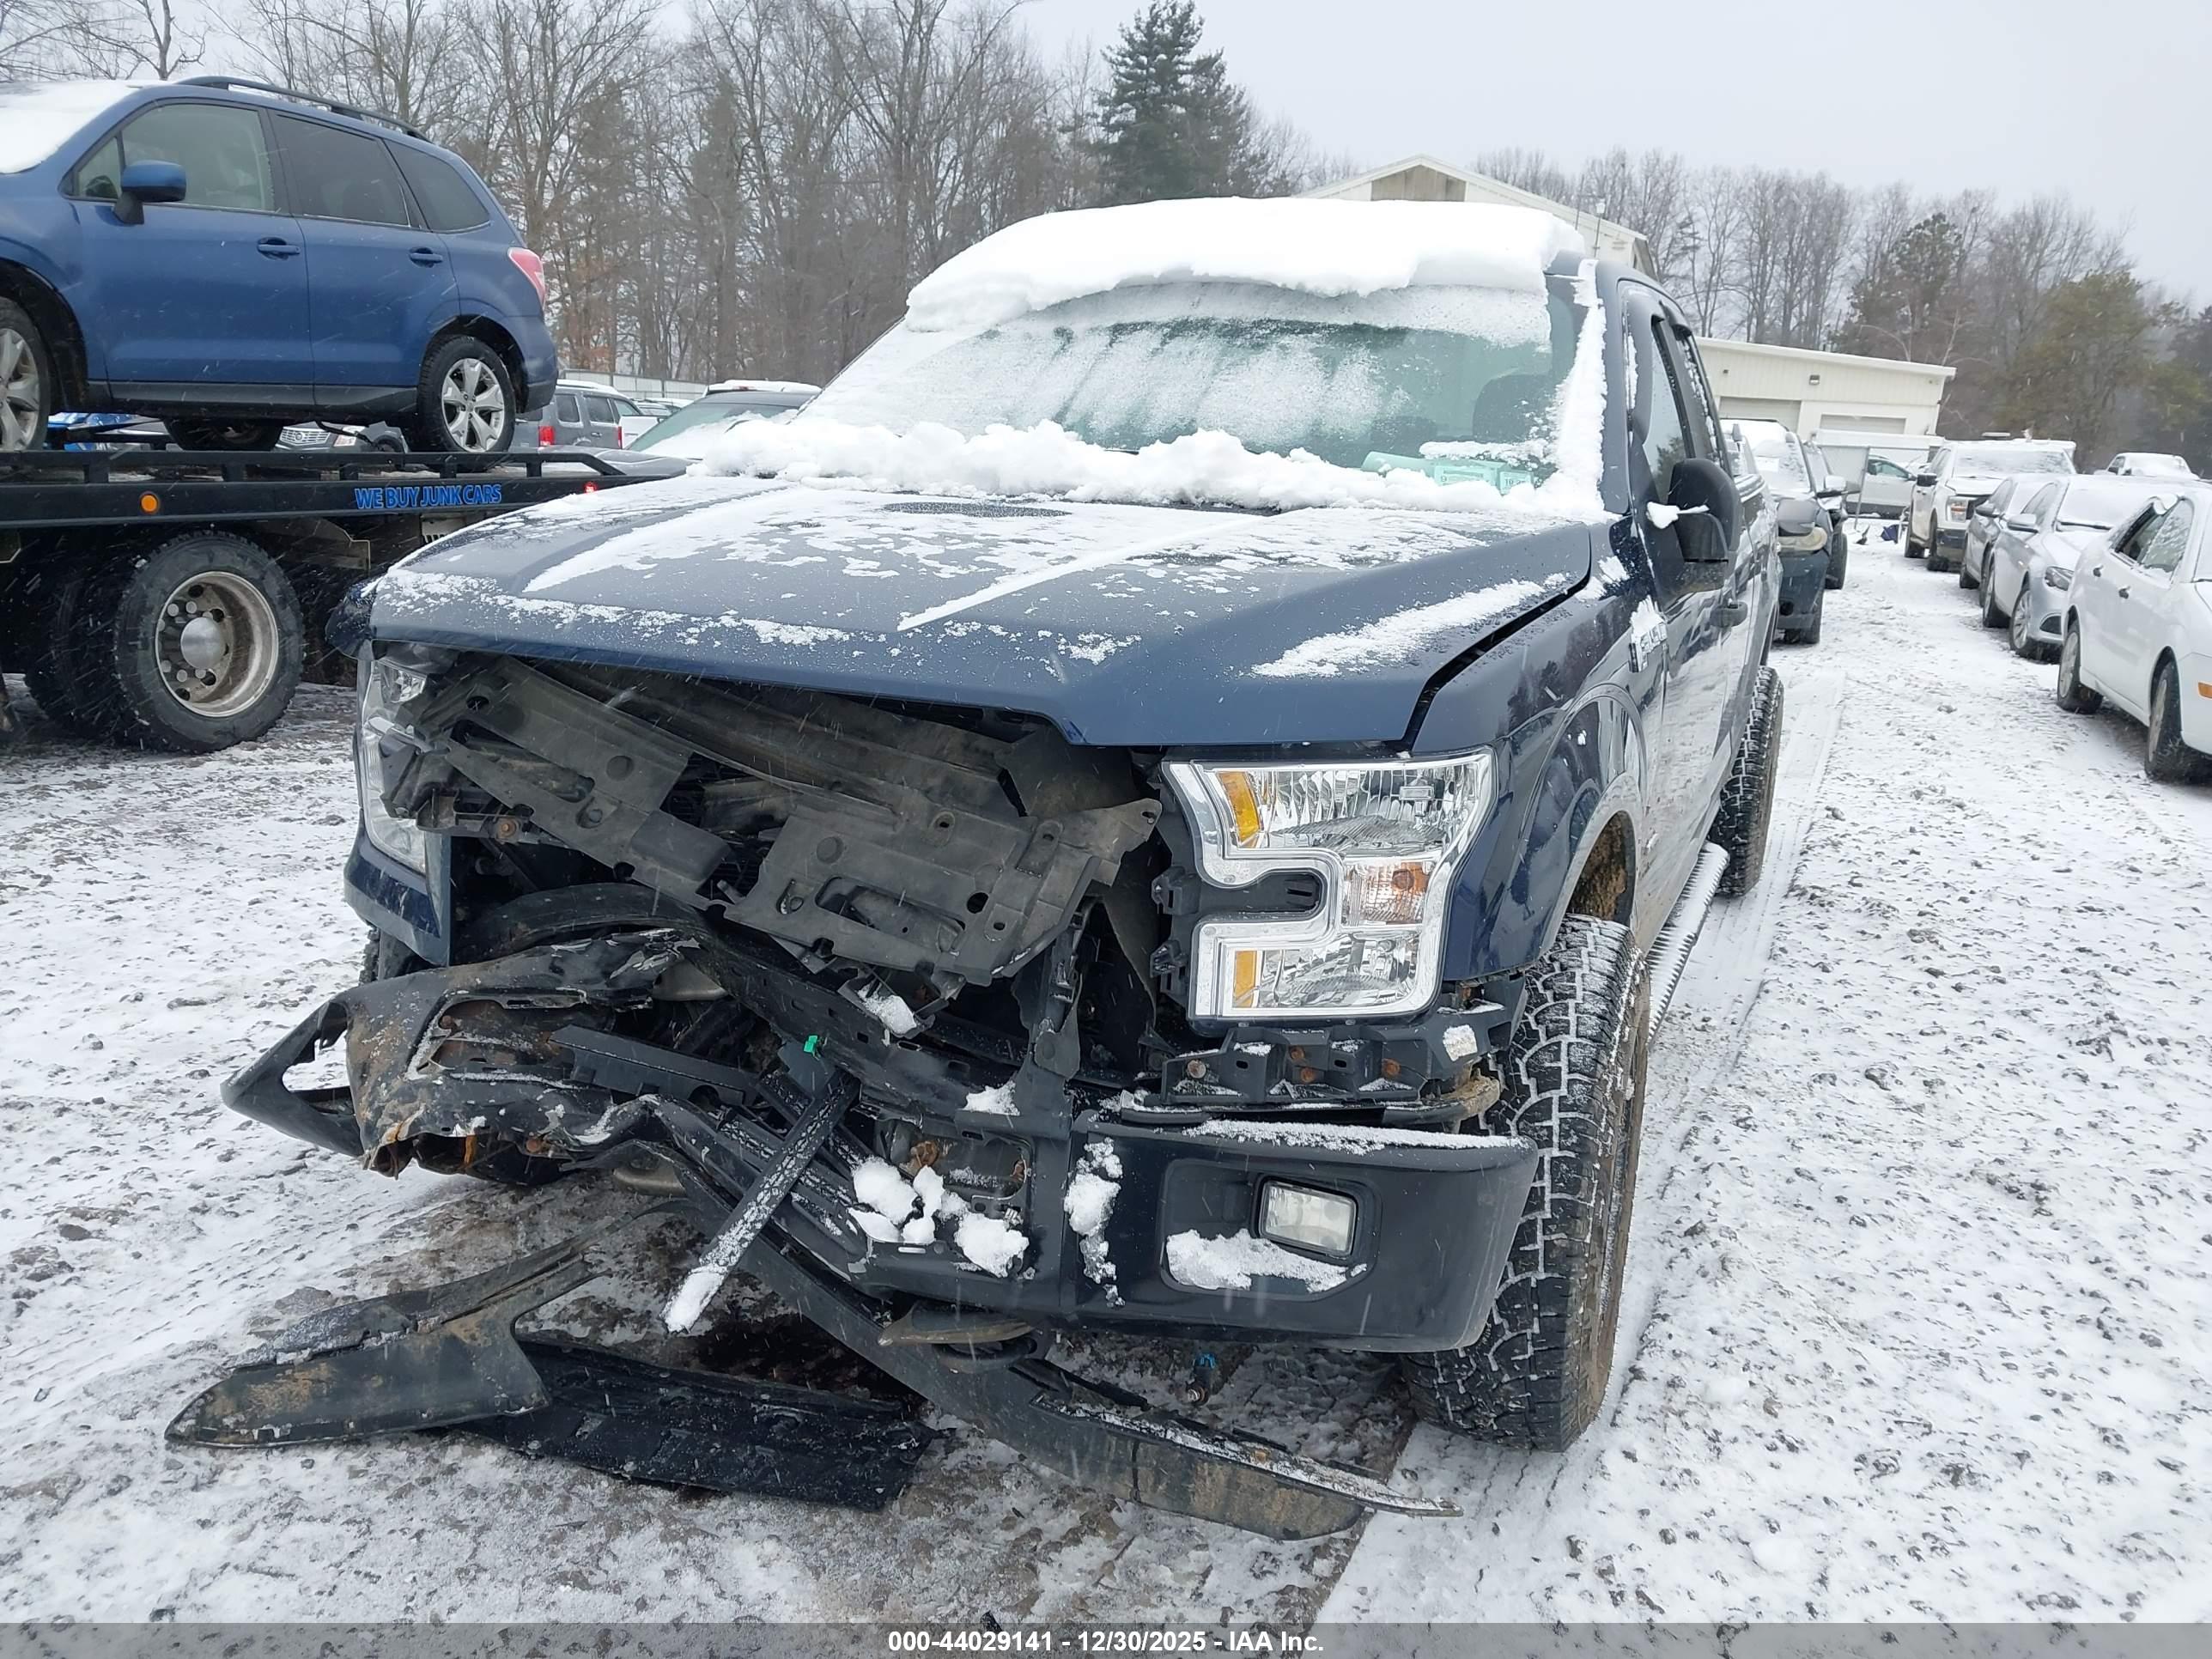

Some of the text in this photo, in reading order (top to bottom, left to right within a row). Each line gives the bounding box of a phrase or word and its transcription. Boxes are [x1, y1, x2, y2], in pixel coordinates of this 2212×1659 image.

[355, 483, 502, 509] WE BUY JUNK CARS
